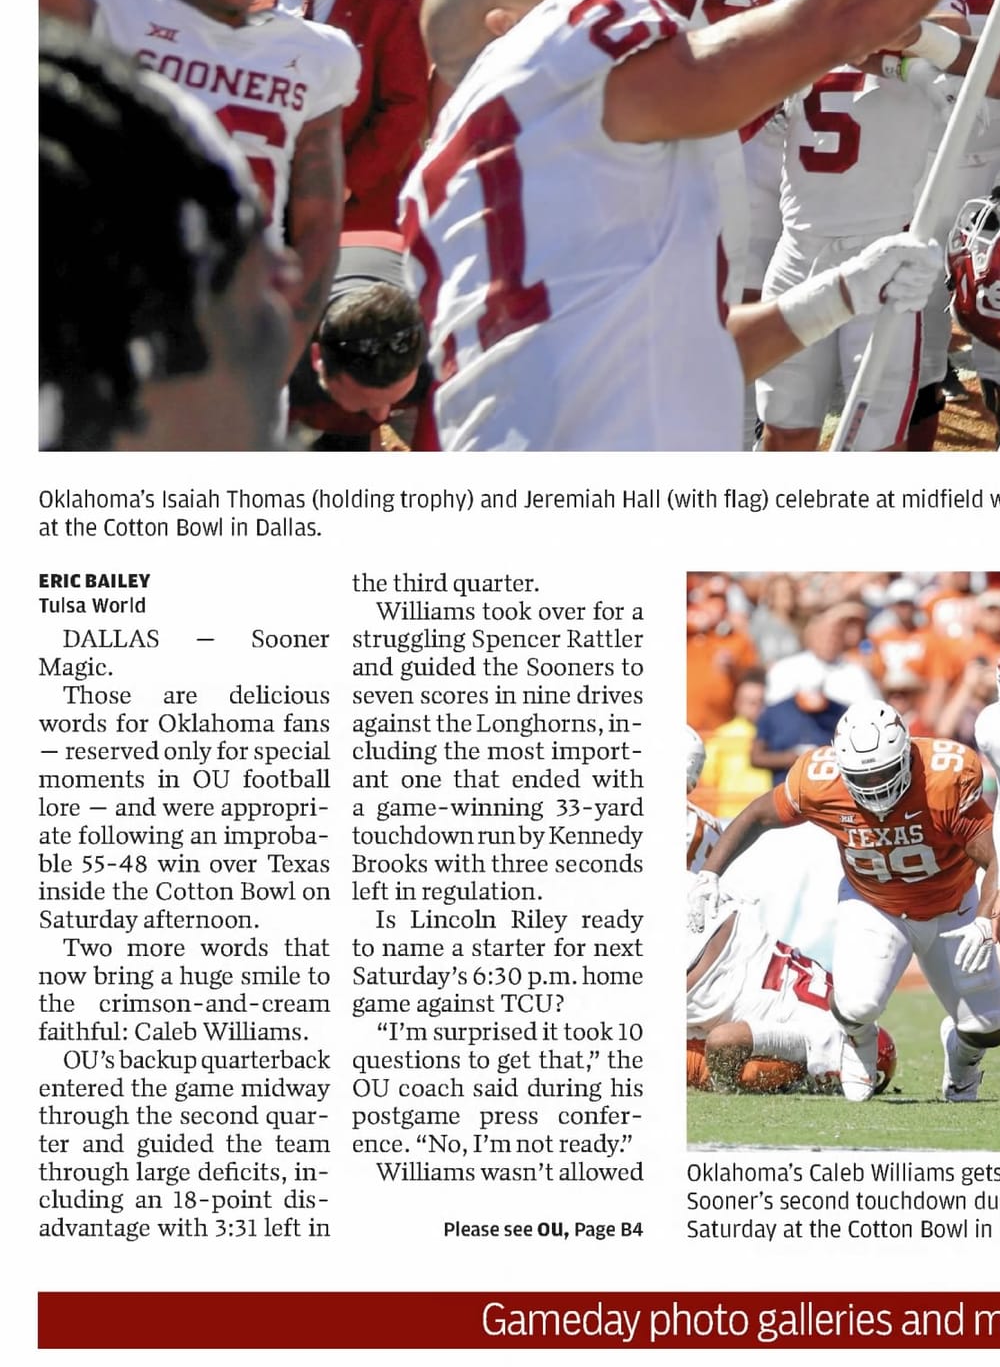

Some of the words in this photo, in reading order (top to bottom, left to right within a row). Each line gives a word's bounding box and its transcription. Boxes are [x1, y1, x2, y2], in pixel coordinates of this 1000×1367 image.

[135, 49, 308, 112] SOONERS
[39, 518, 58, 537] at
[65, 517, 97, 537] the
[103, 518, 168, 537] Cotton
[177, 517, 223, 537] Bowl
[231, 516, 248, 537] in
[256, 517, 322, 537] Dallas.
[39, 573, 81, 589] ERIC
[85, 573, 151, 589] BAILEY
[352, 572, 388, 592] the
[393, 572, 448, 592] third
[453, 574, 539, 598] quarter.
[38, 596, 87, 614] Tulsa
[91, 596, 146, 614] World
[38, 656, 113, 682] Magic.
[845, 823, 924, 849] TEXAS
[844, 843, 942, 884] 99
[351, 880, 389, 901] left
[395, 881, 417, 901] in
[422, 880, 543, 906] regulation.
[39, 908, 139, 934] Saturday
[143, 908, 259, 929] afternoon.
[352, 997, 411, 1018] game
[416, 993, 495, 1018] against
[500, 993, 564, 1013] TCU?
[38, 1021, 128, 1041] faithful:
[134, 1021, 197, 1042] Caleb
[202, 1021, 309, 1041] Williams.
[444, 1220, 500, 1237] Please
[503, 1224, 533, 1237] see
[537, 1222, 570, 1240] OU,
[575, 1222, 616, 1241] Page
[621, 1222, 644, 1237] B4
[687, 1218, 777, 1242] Saturday
[783, 1220, 803, 1239] at
[809, 1218, 841, 1239] the
[848, 1220, 913, 1238] Cotton
[921, 1218, 968, 1238] Bowl
[975, 1218, 992, 1238] in
[482, 1301, 641, 1344] Gameday
[650, 1301, 749, 1344] photo
[757, 1301, 893, 1344] galleries
[901, 1301, 964, 1336] and
